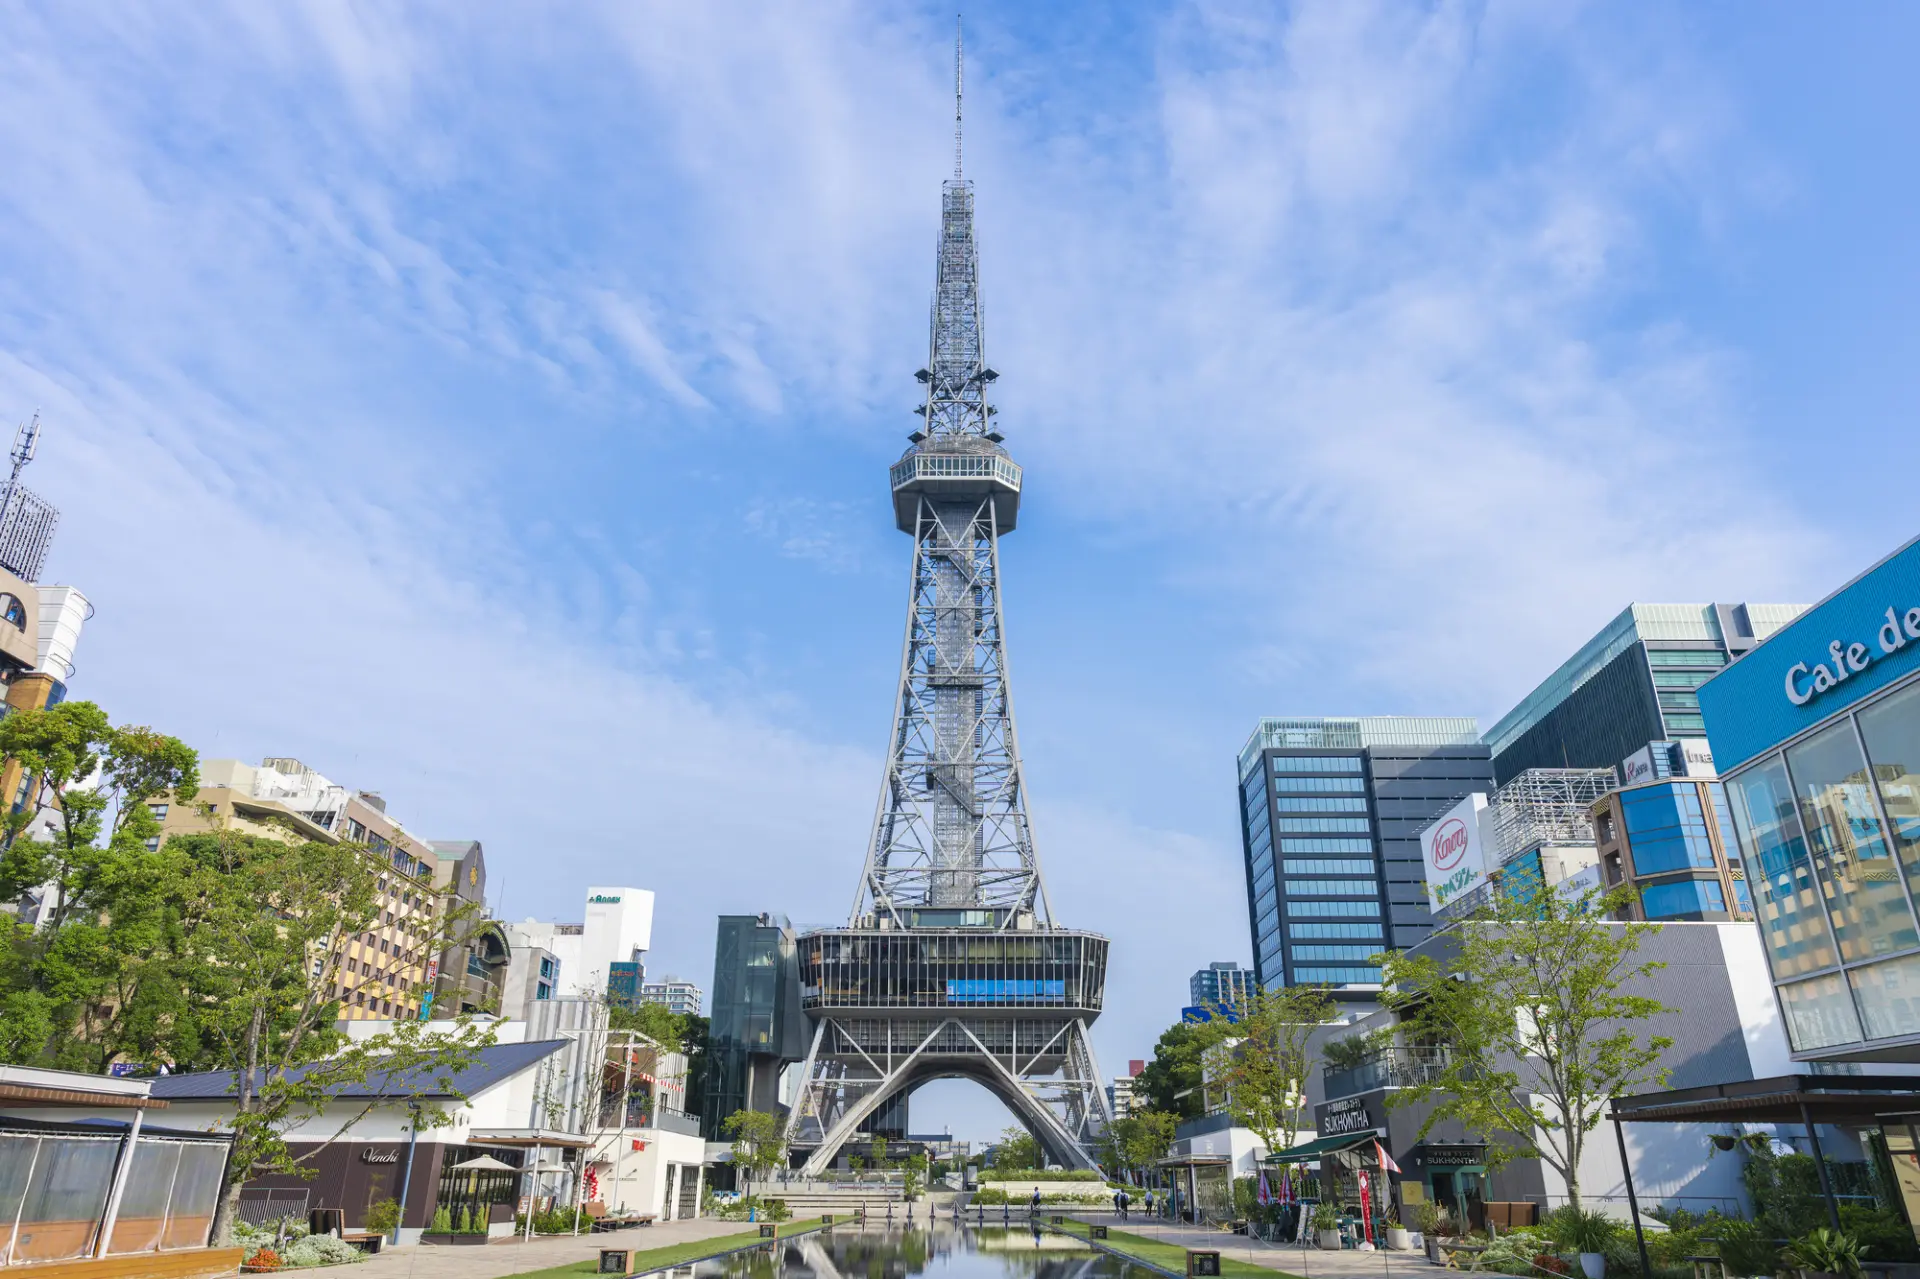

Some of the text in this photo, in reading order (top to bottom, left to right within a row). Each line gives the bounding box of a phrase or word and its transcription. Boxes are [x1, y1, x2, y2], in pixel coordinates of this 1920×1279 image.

[1785, 606, 1920, 705] Cafe de
[1325, 1109, 1369, 1133] SUKHONTHA
[363, 1146, 399, 1163] Venchi
[1427, 1156, 1480, 1165] SUKHONTHA
